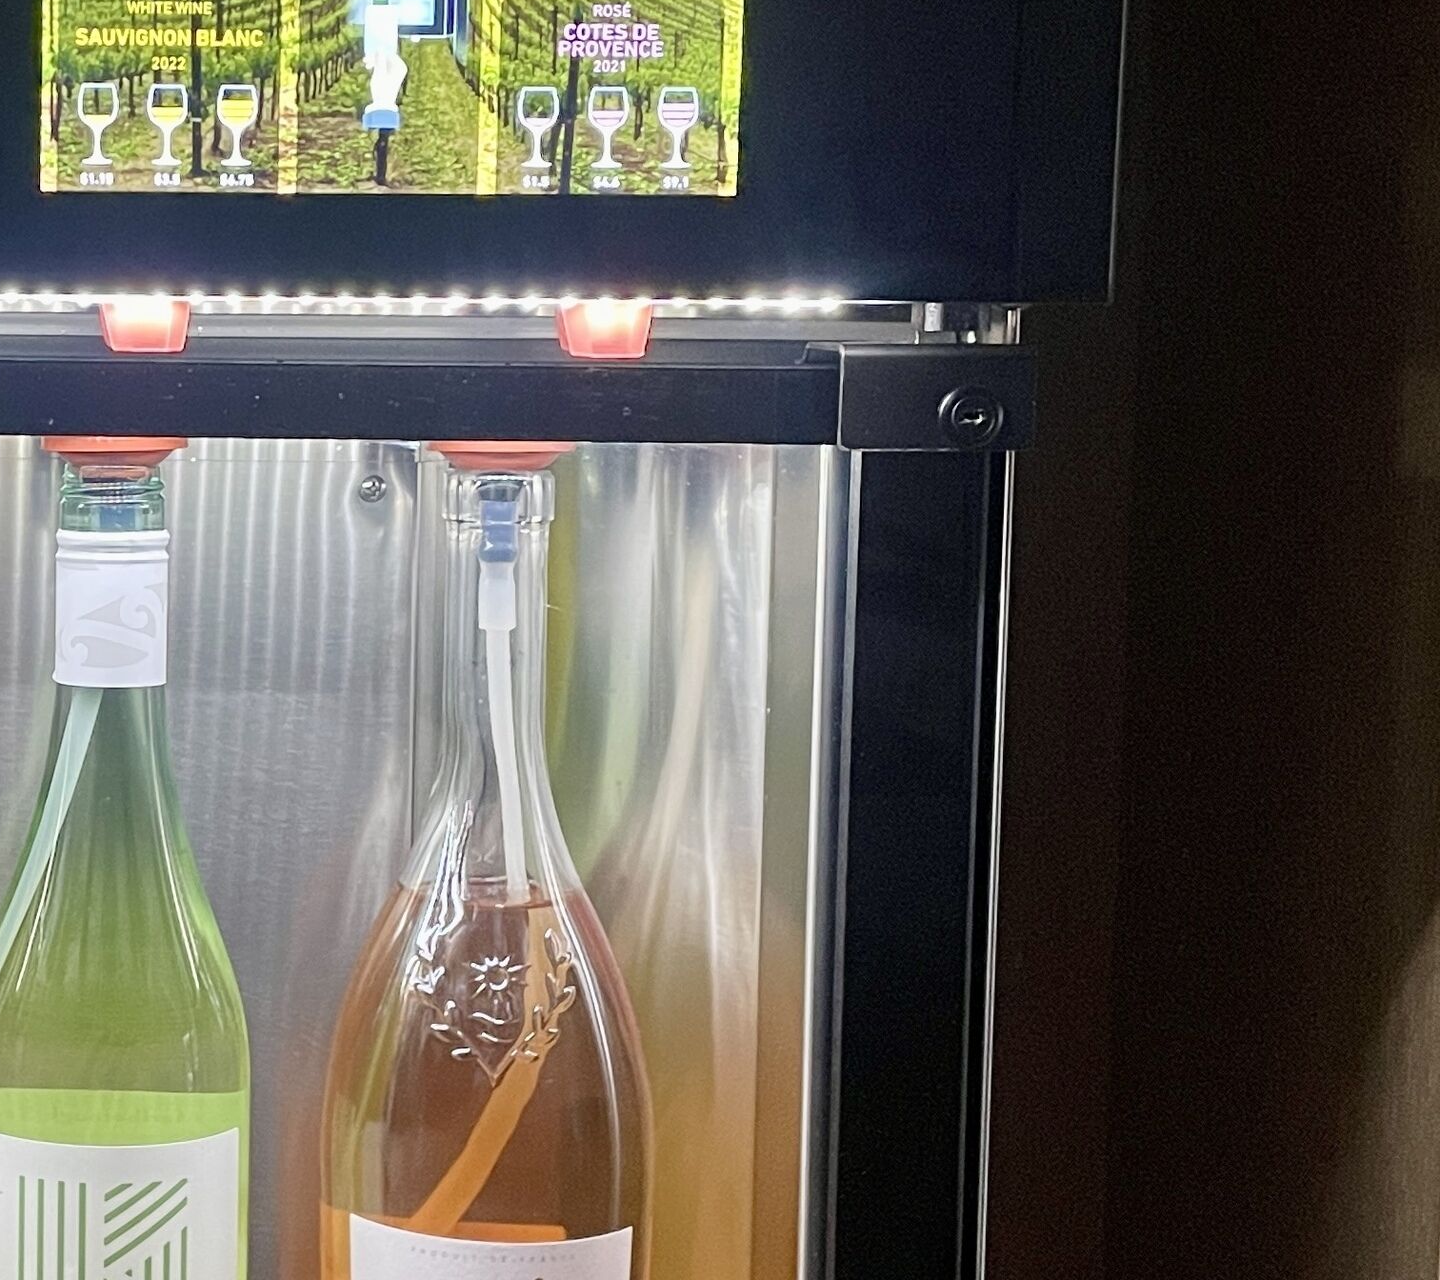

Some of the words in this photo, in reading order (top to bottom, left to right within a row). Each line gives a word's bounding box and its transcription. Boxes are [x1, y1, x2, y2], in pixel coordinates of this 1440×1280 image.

[126, 0, 173, 15] WHITE
[174, 1, 213, 15] WINE
[592, 1, 632, 18] ROSÉ
[75, 27, 192, 47] SAUVIGNON
[196, 29, 264, 47] BLANC
[632, 23, 660, 41] DE
[557, 40, 664, 58] PROVENCE
[151, 56, 186, 71] 2022
[593, 60, 626, 73] 2021
